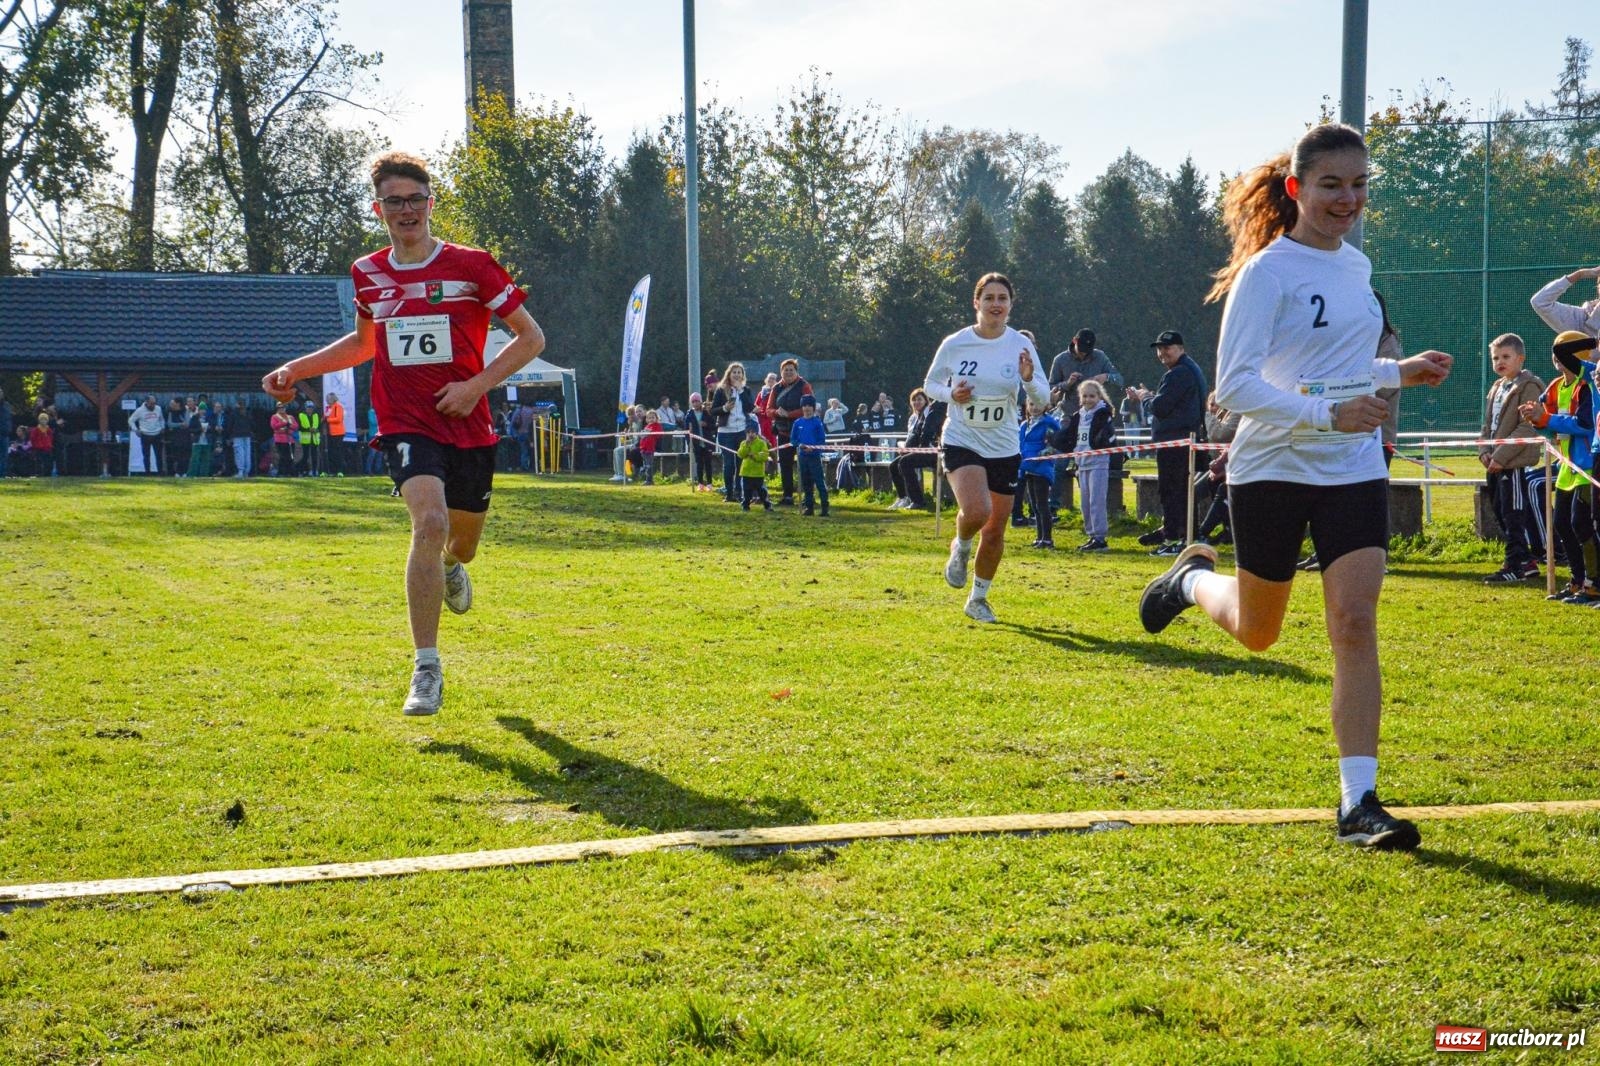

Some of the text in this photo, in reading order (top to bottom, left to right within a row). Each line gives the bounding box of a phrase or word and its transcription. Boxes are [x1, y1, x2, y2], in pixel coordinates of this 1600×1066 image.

[1310, 294, 1328, 329] 2
[399, 333, 437, 356] 76
[958, 360, 978, 376] 22
[966, 405, 1004, 421] 110
